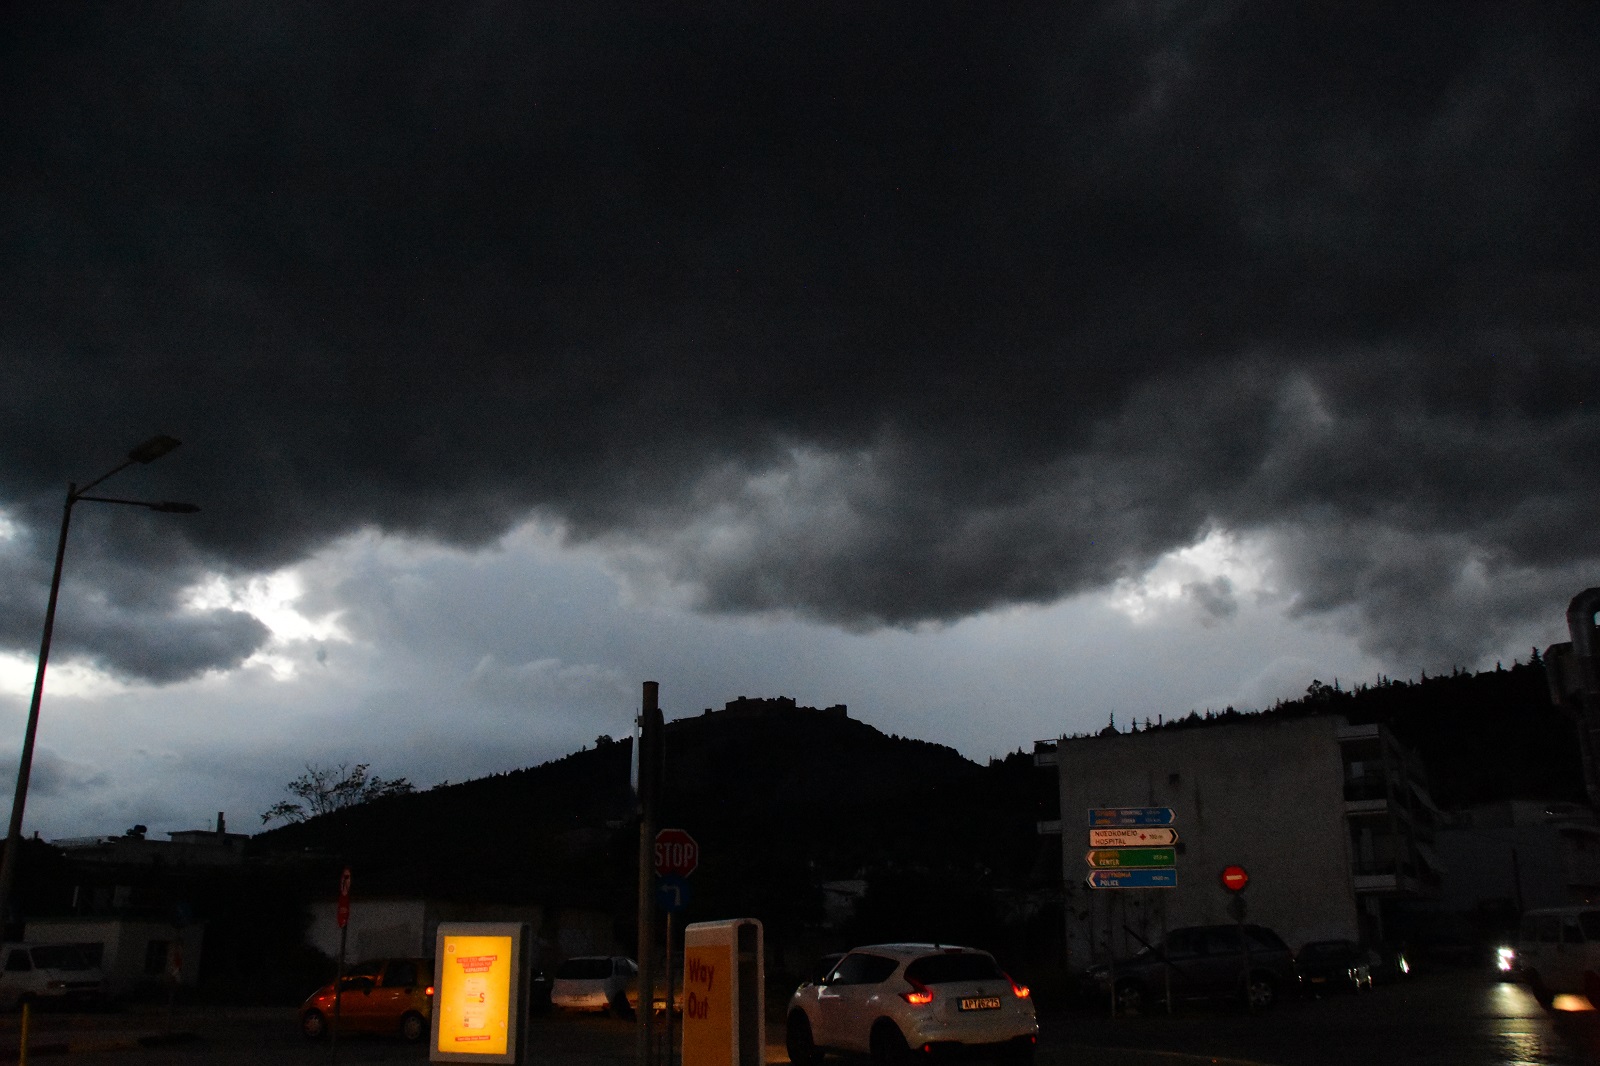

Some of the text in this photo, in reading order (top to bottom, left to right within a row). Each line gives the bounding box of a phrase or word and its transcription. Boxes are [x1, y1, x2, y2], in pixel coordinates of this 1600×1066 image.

[654, 842, 693, 868] STOP
[689, 957, 714, 992] Way
[688, 991, 709, 1020] Out
